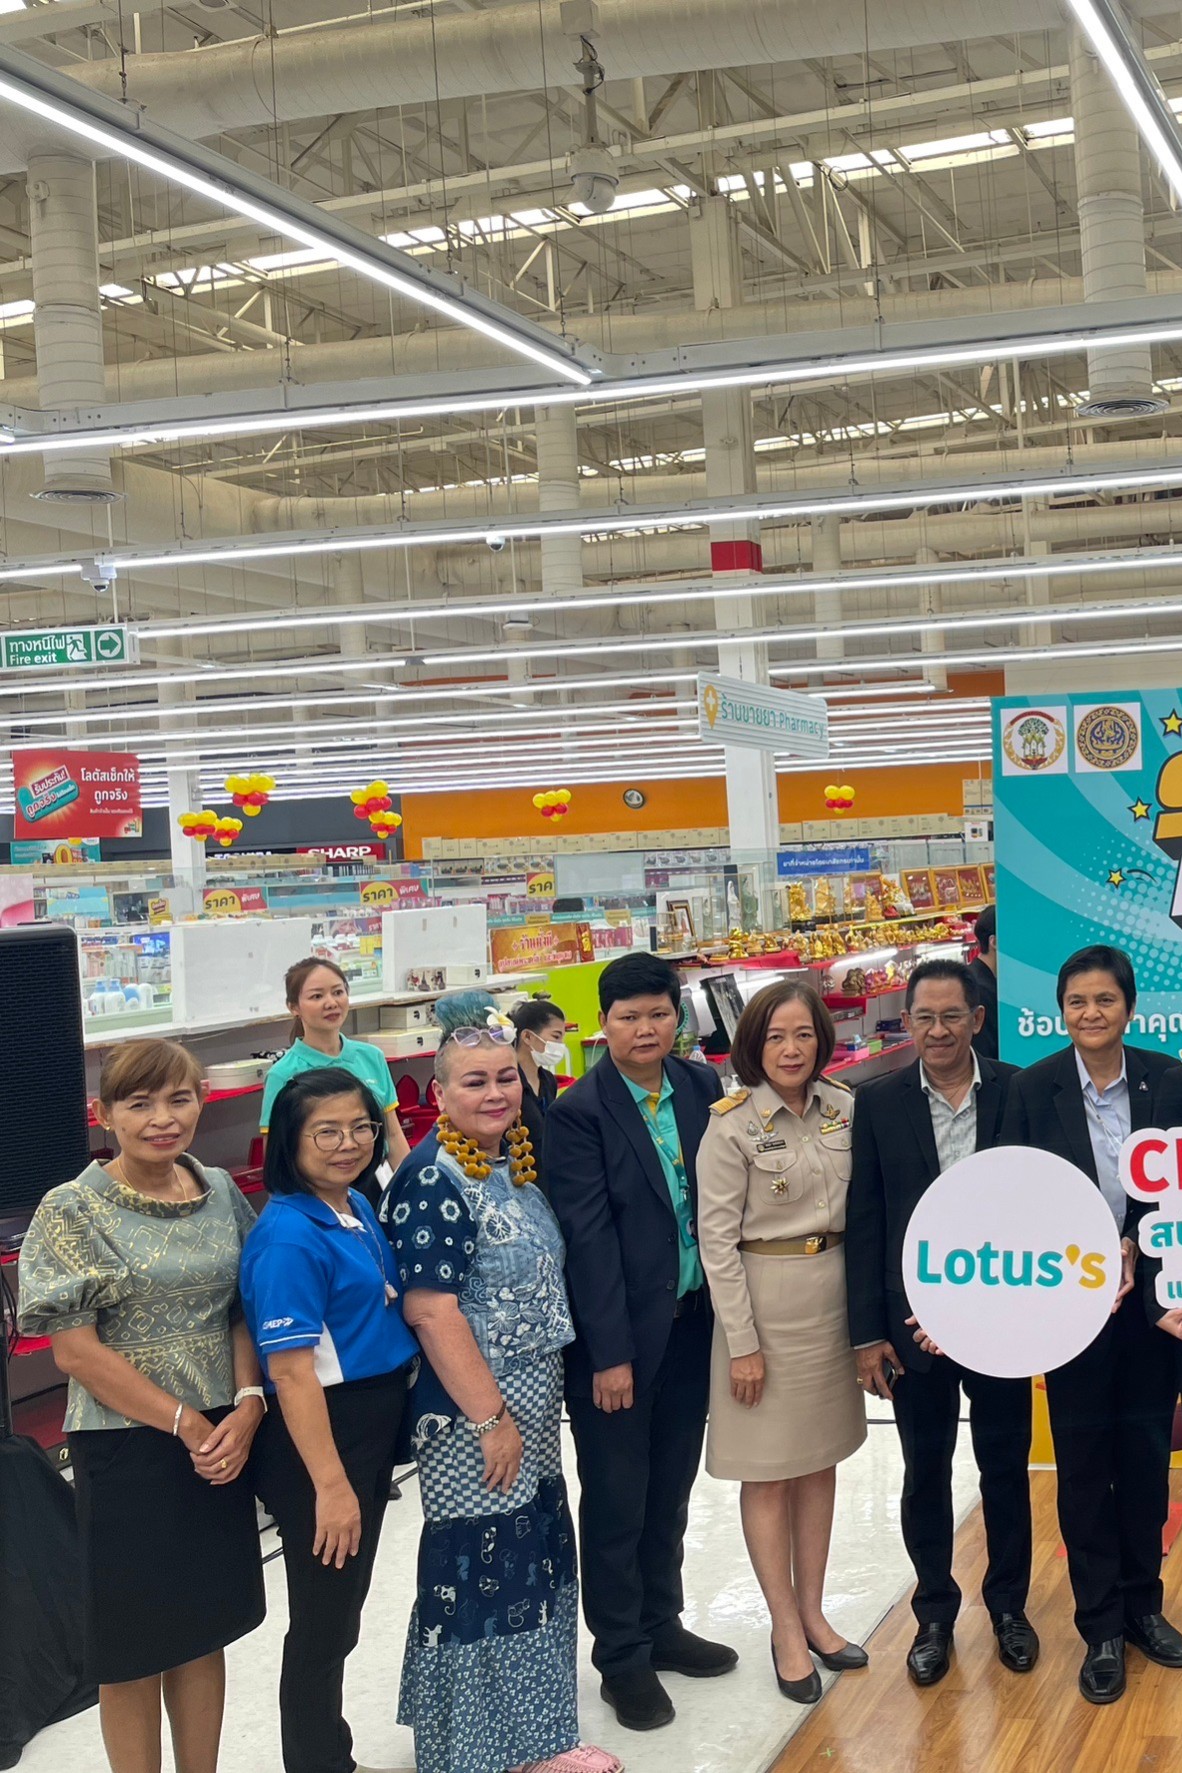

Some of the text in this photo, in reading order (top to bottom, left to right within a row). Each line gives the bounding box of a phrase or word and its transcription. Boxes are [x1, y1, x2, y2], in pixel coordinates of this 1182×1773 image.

[9, 635, 65, 653] ทางหนีไฟ
[10, 652, 57, 665] Fire exit
[721, 692, 825, 738] ร้านขายยา Pharmacy
[94, 787, 128, 805] ถูกจริง
[205, 895, 236, 910] ราคา
[362, 887, 394, 903] ราคา
[916, 1239, 1107, 1289] Lotus's
